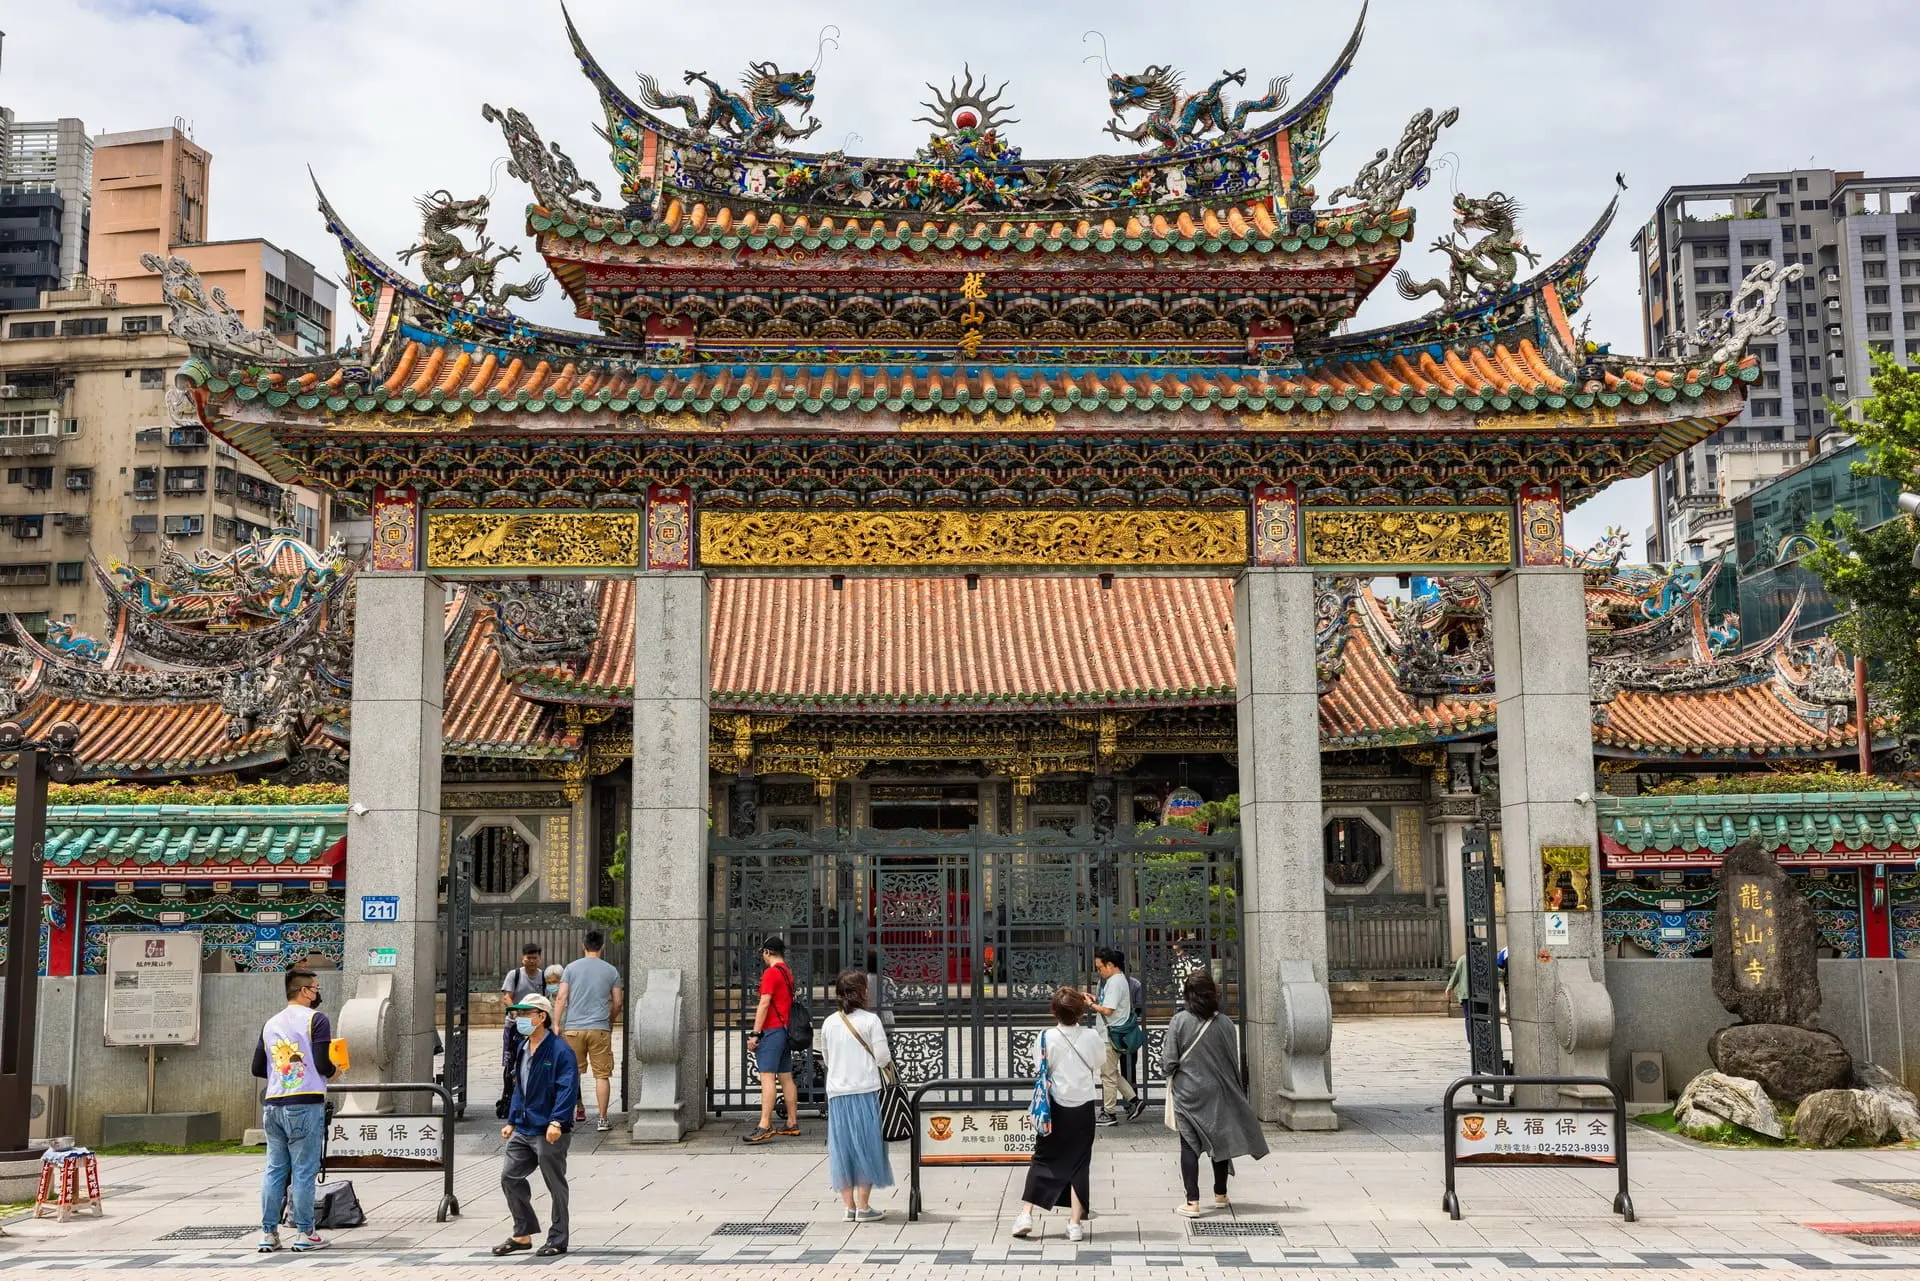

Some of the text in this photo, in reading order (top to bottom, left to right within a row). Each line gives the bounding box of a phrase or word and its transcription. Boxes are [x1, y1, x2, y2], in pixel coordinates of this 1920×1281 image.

[958, 271, 988, 359] 龍山寺
[367, 905, 393, 918] 211
[1738, 883, 1765, 985] 龍山寺
[377, 955, 393, 964] 211
[331, 1124, 438, 1142] 良福保全
[1494, 1117, 1608, 1136] 良福保全
[371, 1148, 438, 1157] 02-2523-8939
[1538, 1143, 1610, 1153] 02-2523-8939
